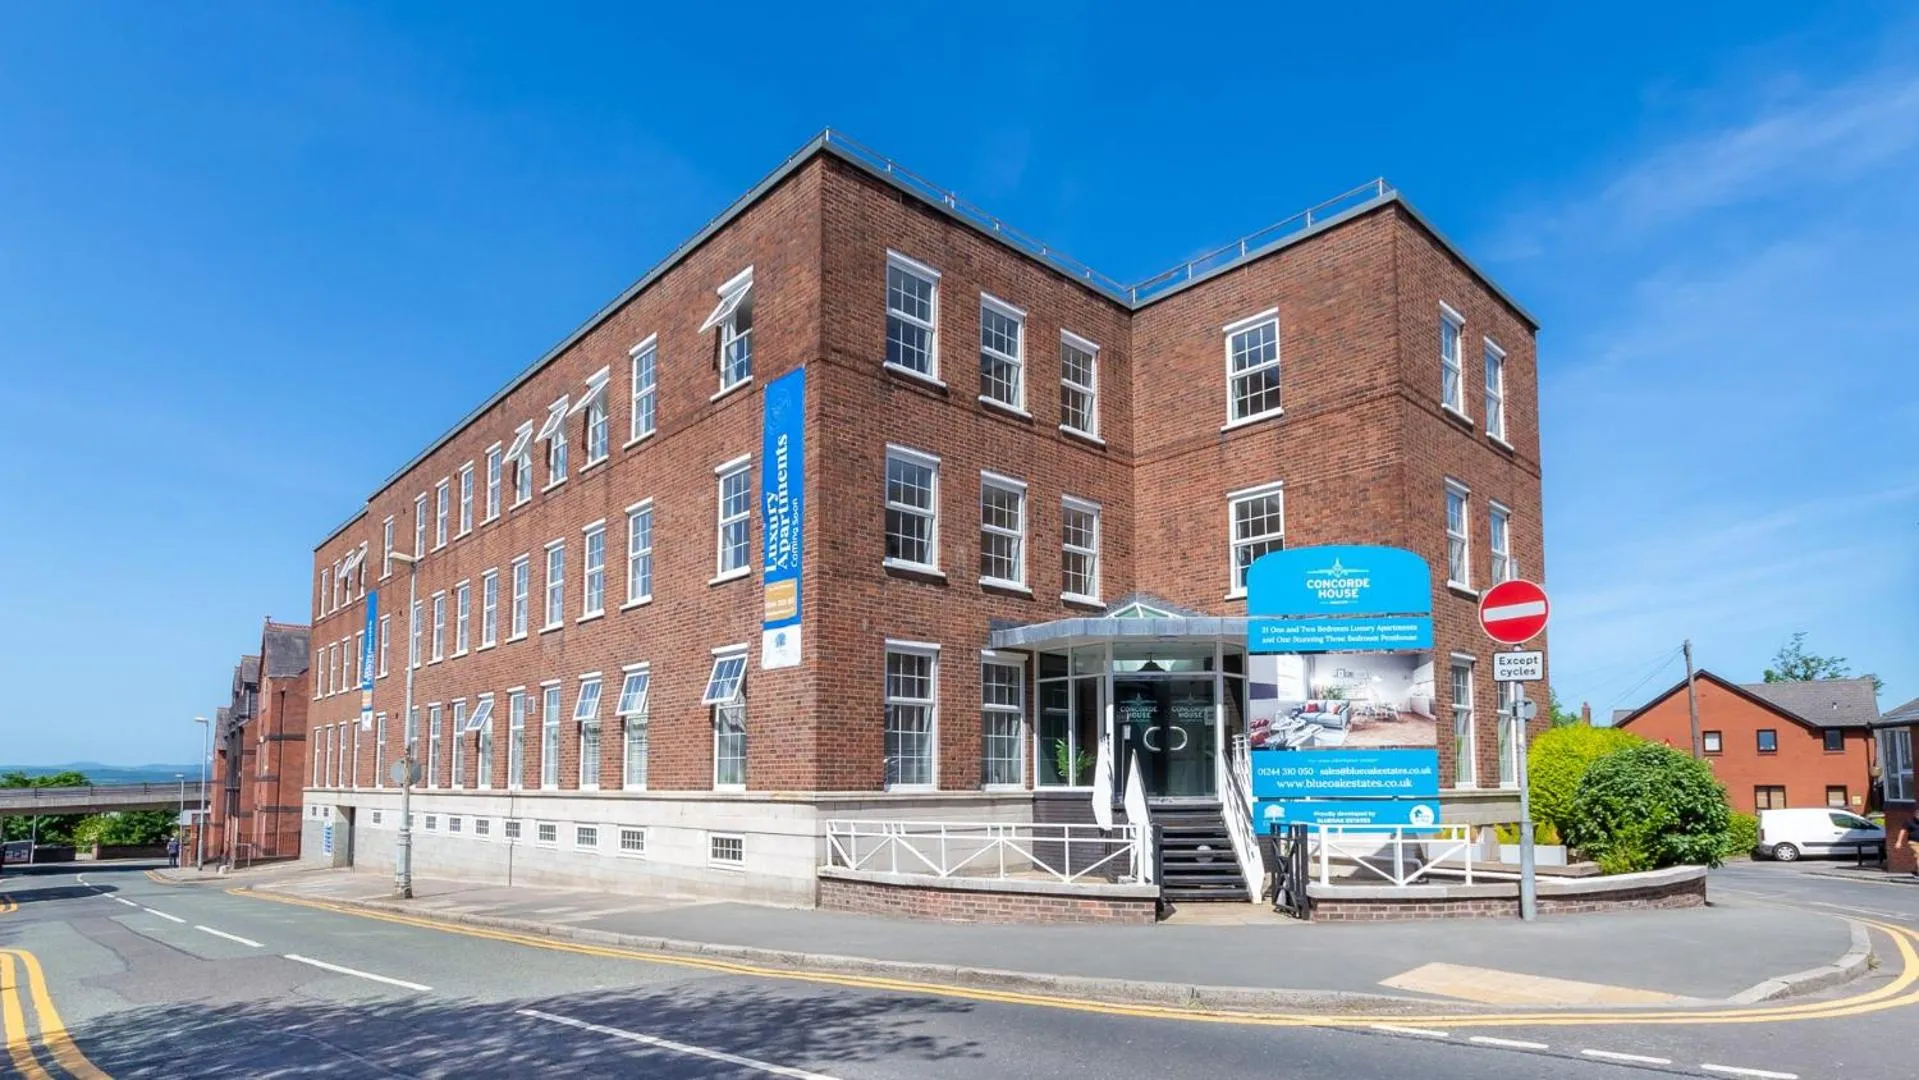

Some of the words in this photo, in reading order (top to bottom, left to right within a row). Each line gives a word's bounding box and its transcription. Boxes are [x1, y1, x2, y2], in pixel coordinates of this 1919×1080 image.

[776, 433, 790, 569] Apartments
[764, 491, 778, 573] Luxury
[791, 528, 799, 567] Coming
[1306, 578, 1371, 589] CONCORDE
[1318, 588, 1359, 598] HOUSE
[1301, 625, 1316, 633] Two
[1350, 624, 1375, 632] Luxury
[1498, 655, 1538, 666] Except
[1500, 667, 1536, 677] cycles
[1257, 767, 1280, 776] 01244
[1281, 767, 1296, 776] 310
[1297, 767, 1314, 776] 050
[1320, 766, 1432, 775] sales@blueoakestates.co.uk
[1276, 778, 1412, 789] www.blueoakestates.co.uk
